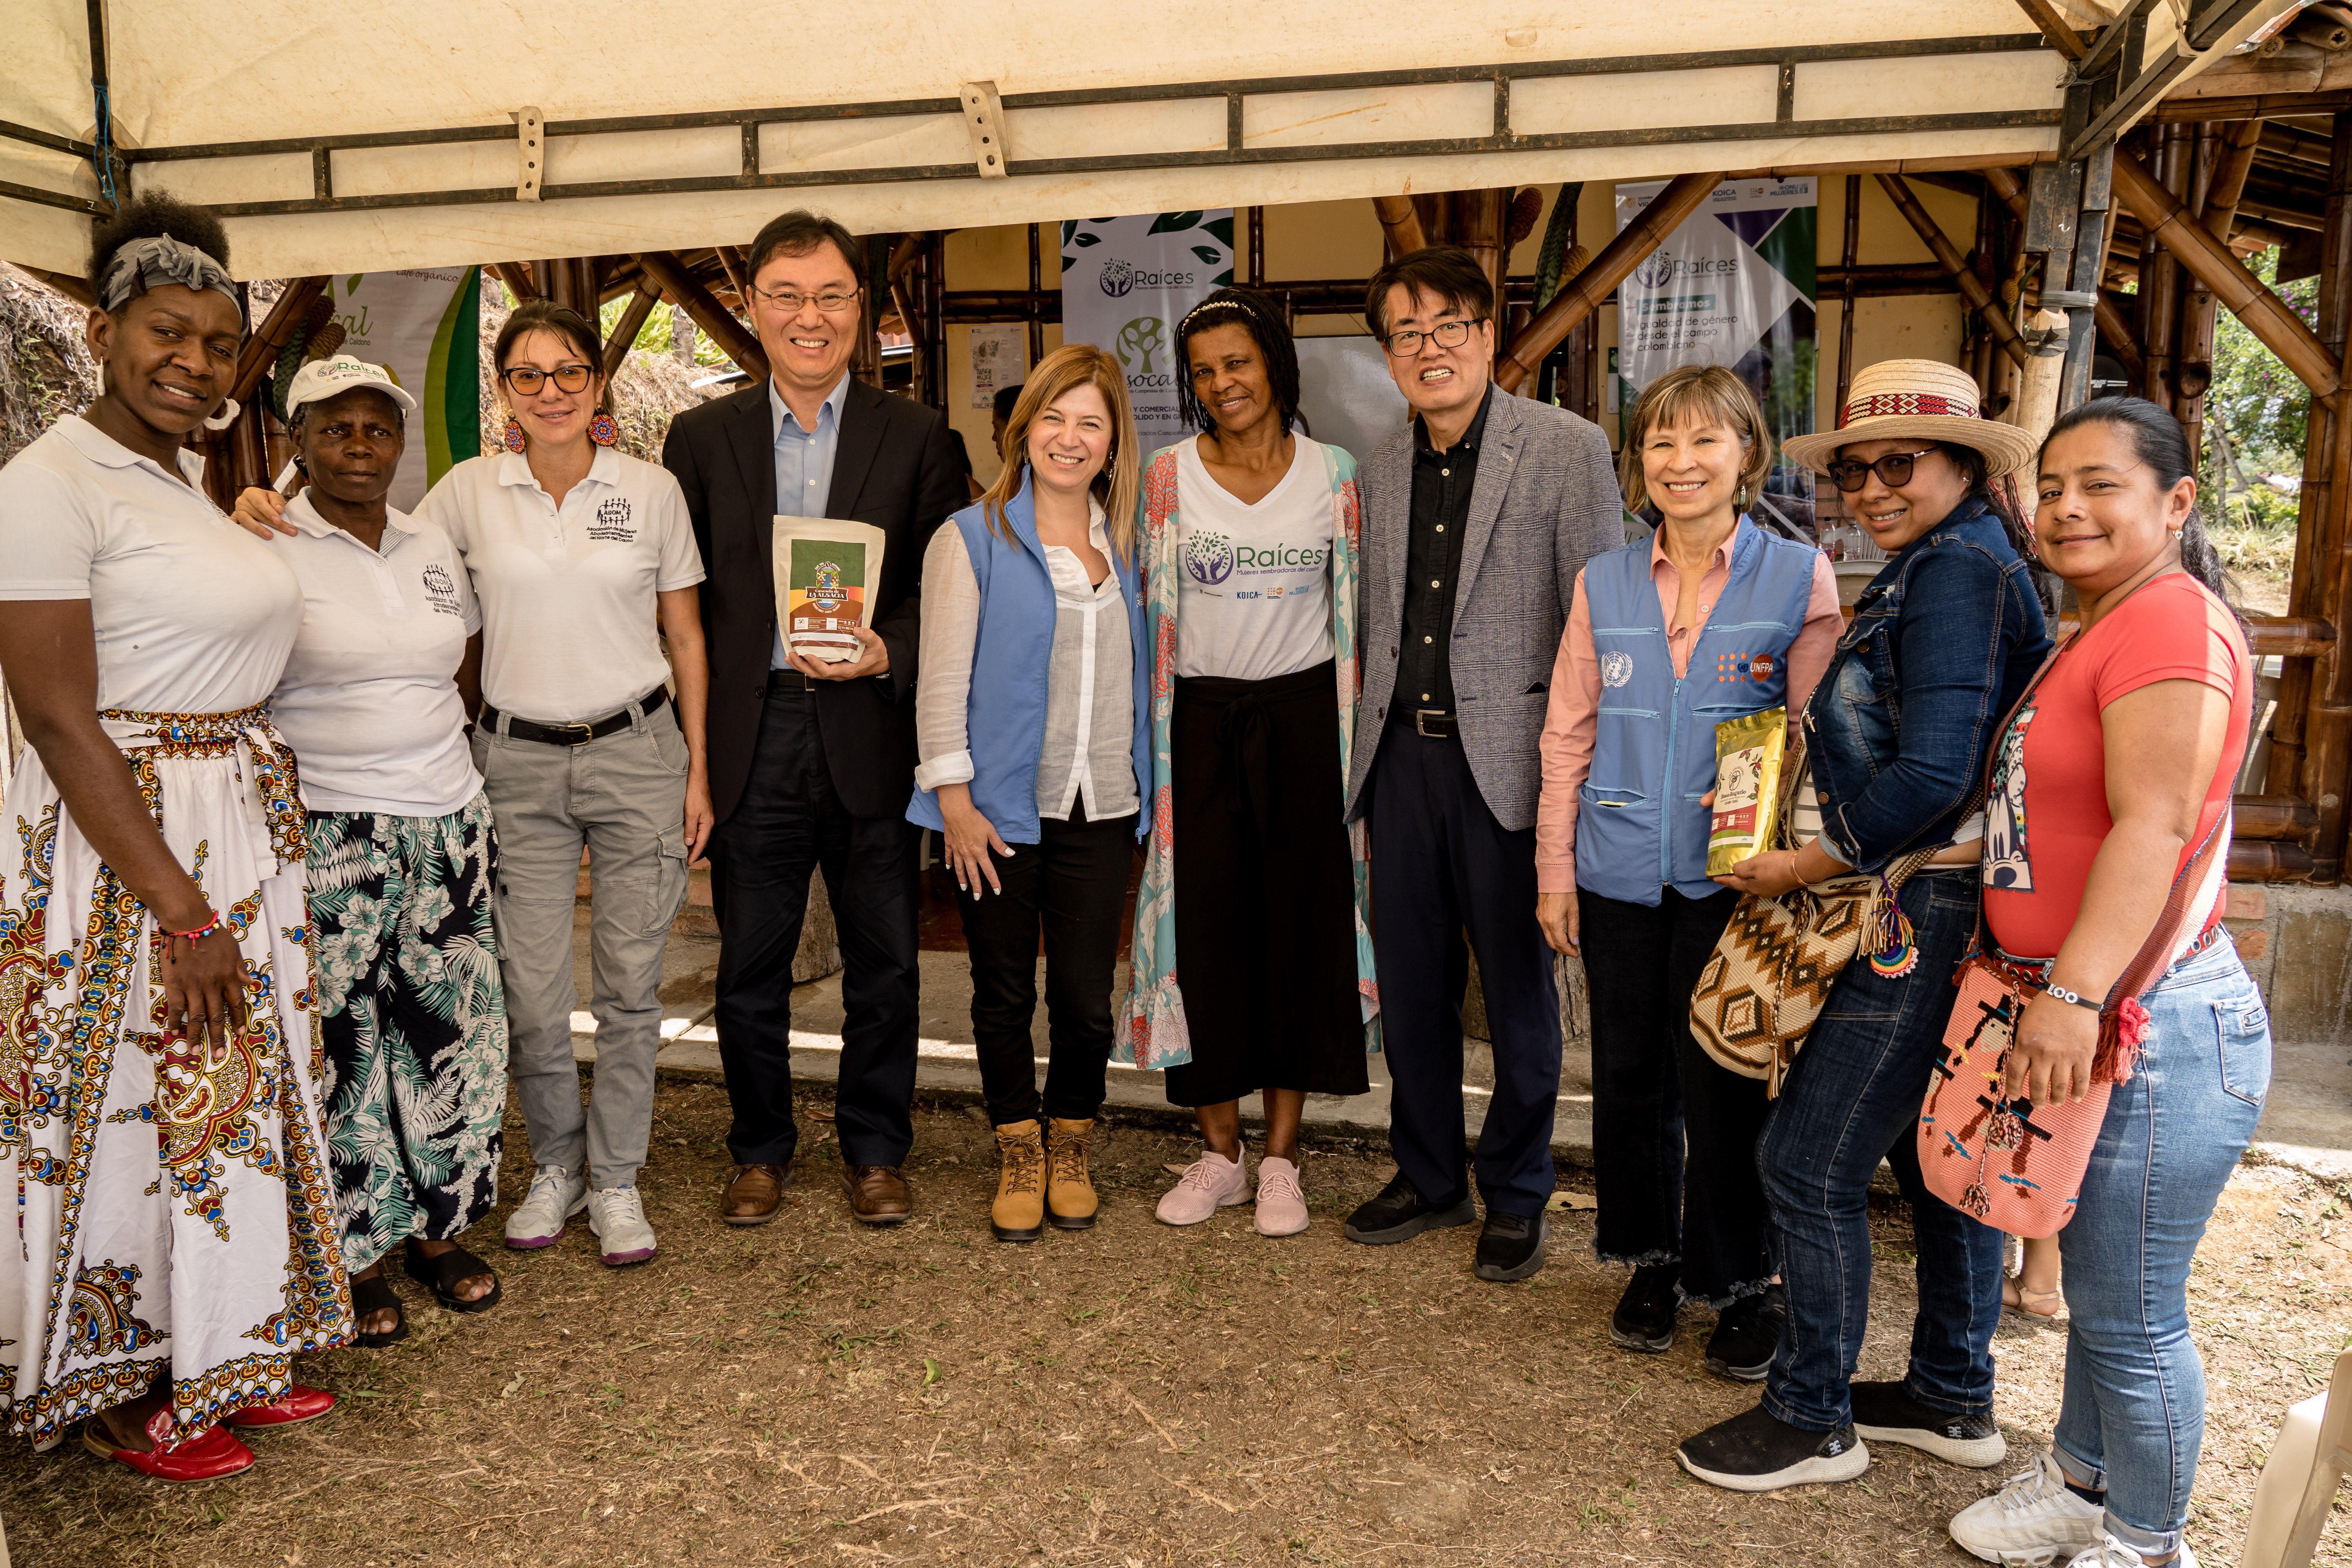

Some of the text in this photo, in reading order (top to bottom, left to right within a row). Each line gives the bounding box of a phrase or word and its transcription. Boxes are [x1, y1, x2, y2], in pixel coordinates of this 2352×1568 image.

[1673, 257, 1738, 275] Raíces
[1135, 269, 1194, 285] Raíces
[1641, 299, 1710, 312] Sembramos
[1637, 316, 1739, 330] Igualdad de género
[1637, 328, 1718, 341] desde el campo
[349, 338, 371, 346] Caldono
[1637, 340, 1696, 352] colombiano
[1236, 543, 1323, 568] Raíces
[430, 577, 448, 586] ASOM
[1236, 591, 1258, 599] KOICA
[1749, 662, 1773, 673] UNFPA
